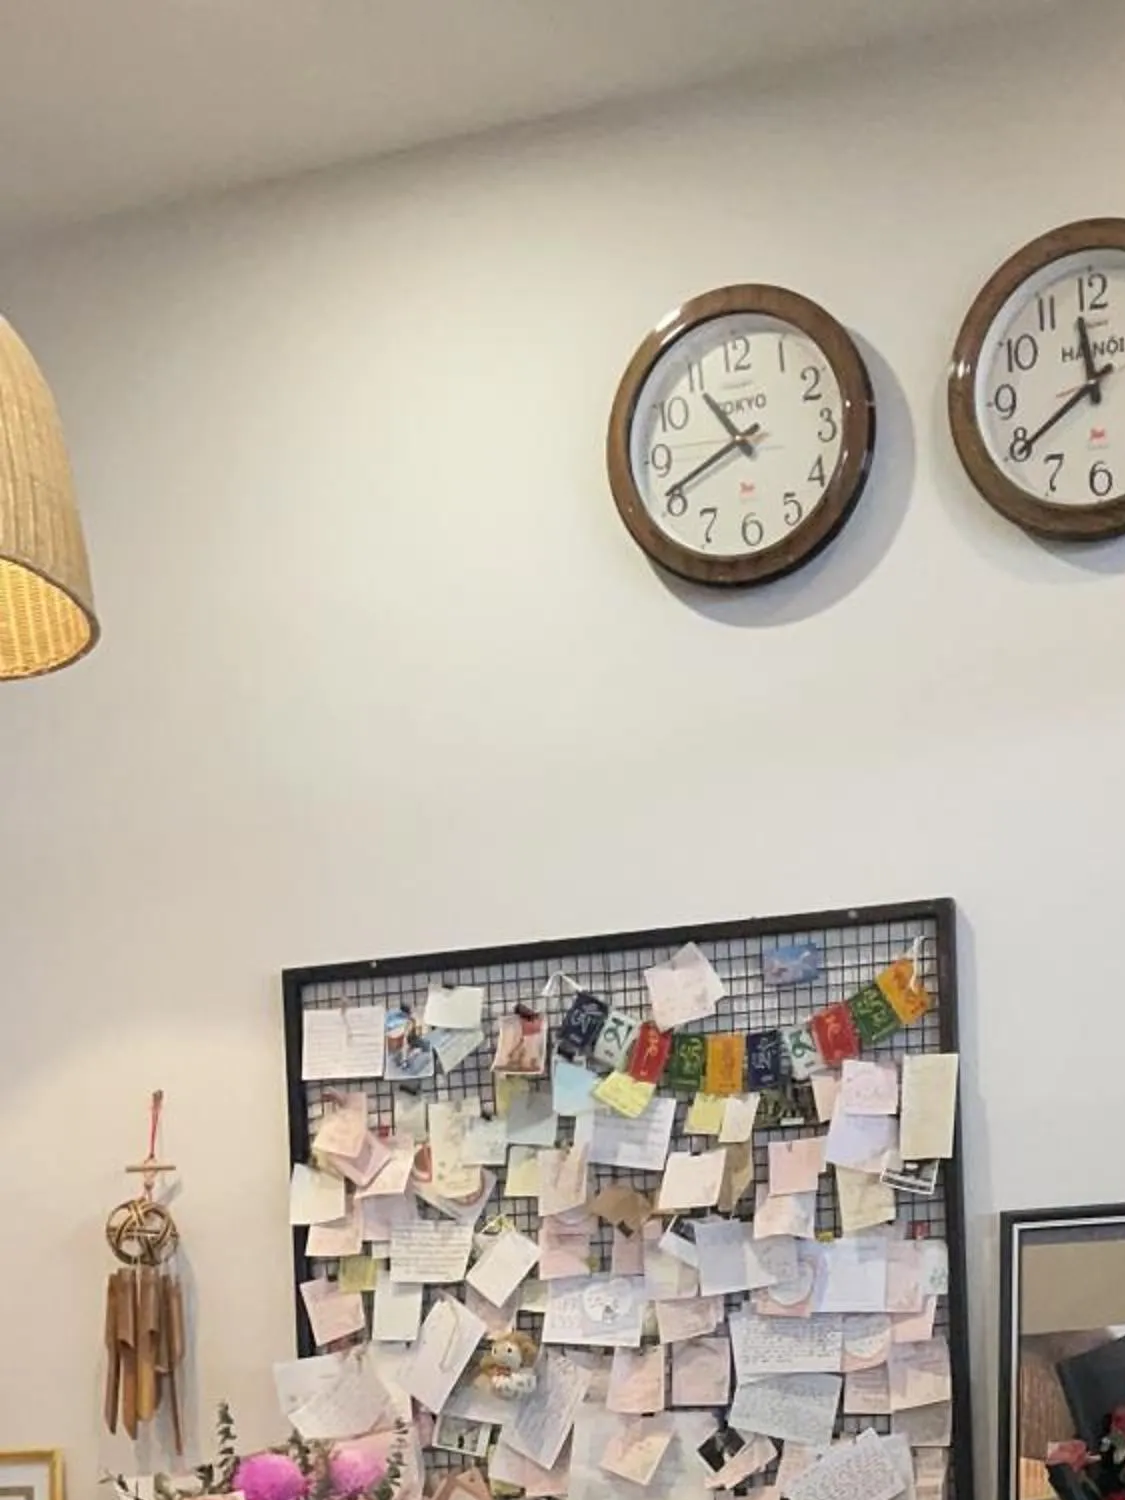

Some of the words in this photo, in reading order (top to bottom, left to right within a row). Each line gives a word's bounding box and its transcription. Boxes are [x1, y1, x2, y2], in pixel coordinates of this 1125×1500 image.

[1078, 274, 1107, 311] 12
[1038, 295, 1055, 331] 11
[723, 337, 751, 373] 12
[779, 341, 785, 373] 1
[1007, 334, 1037, 372] 10
[688, 361, 704, 392] 11
[801, 367, 822, 402] 2
[660, 396, 688, 432] 10
[995, 384, 1017, 420] 9
[818, 408, 837, 442] 3
[651, 444, 671, 478] 9
[1010, 427, 1032, 463] 8
[807, 454, 825, 488] 4
[1044, 454, 1064, 491] 7
[1089, 460, 1112, 496] 6
[666, 486, 688, 516] 8
[784, 492, 802, 526] 5
[700, 507, 717, 543] 7
[741, 512, 764, 546] 6
